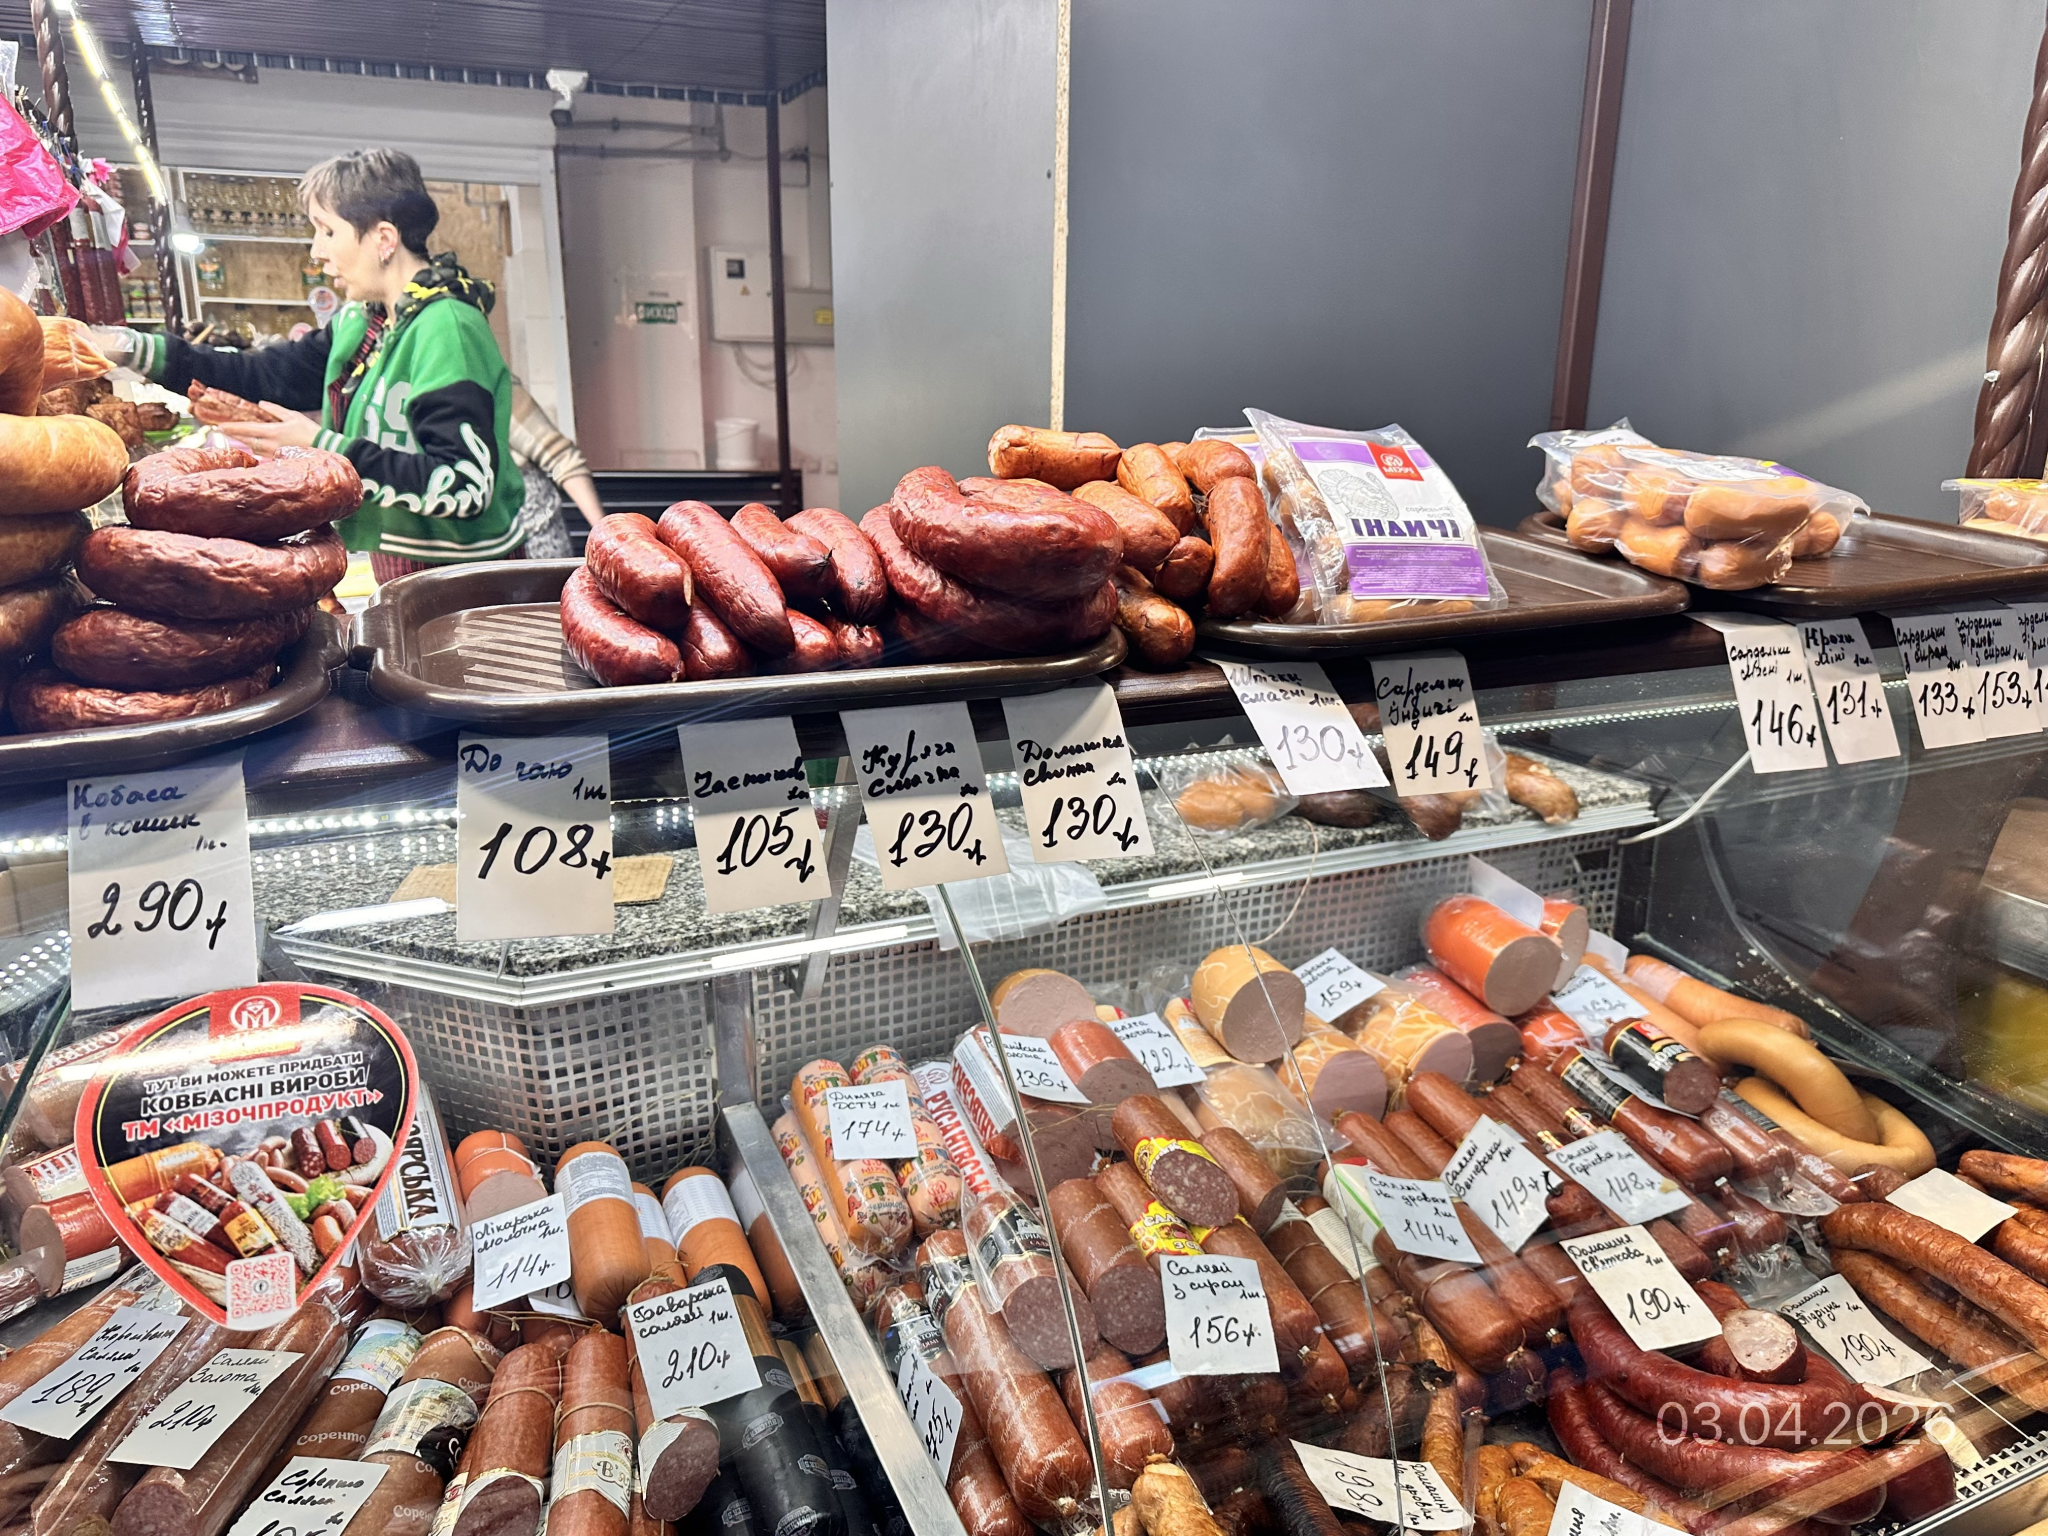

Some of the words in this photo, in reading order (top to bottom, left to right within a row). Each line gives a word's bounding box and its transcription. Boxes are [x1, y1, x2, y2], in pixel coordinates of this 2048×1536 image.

[1352, 518, 1462, 538] ІНДИЧІ
[141, 1083, 263, 1115] КОВБАСНІ
[270, 1069, 365, 1096] ВИРОБИ
[146, 1079, 177, 1093] ТУТ
[180, 1074, 202, 1087] ВИ
[206, 1064, 275, 1084] МОЖЕТЕ
[279, 1052, 362, 1074] ПРИДБАТИ
[123, 1120, 160, 1141] ТМ
[163, 1089, 384, 1132] «МІЗОЧПРОДУКТ»
[833, 1101, 877, 1111] ДСТУ
[927, 1089, 994, 1196] РУСАНІВСЬК
[296, 1430, 368, 1447] Соренто
